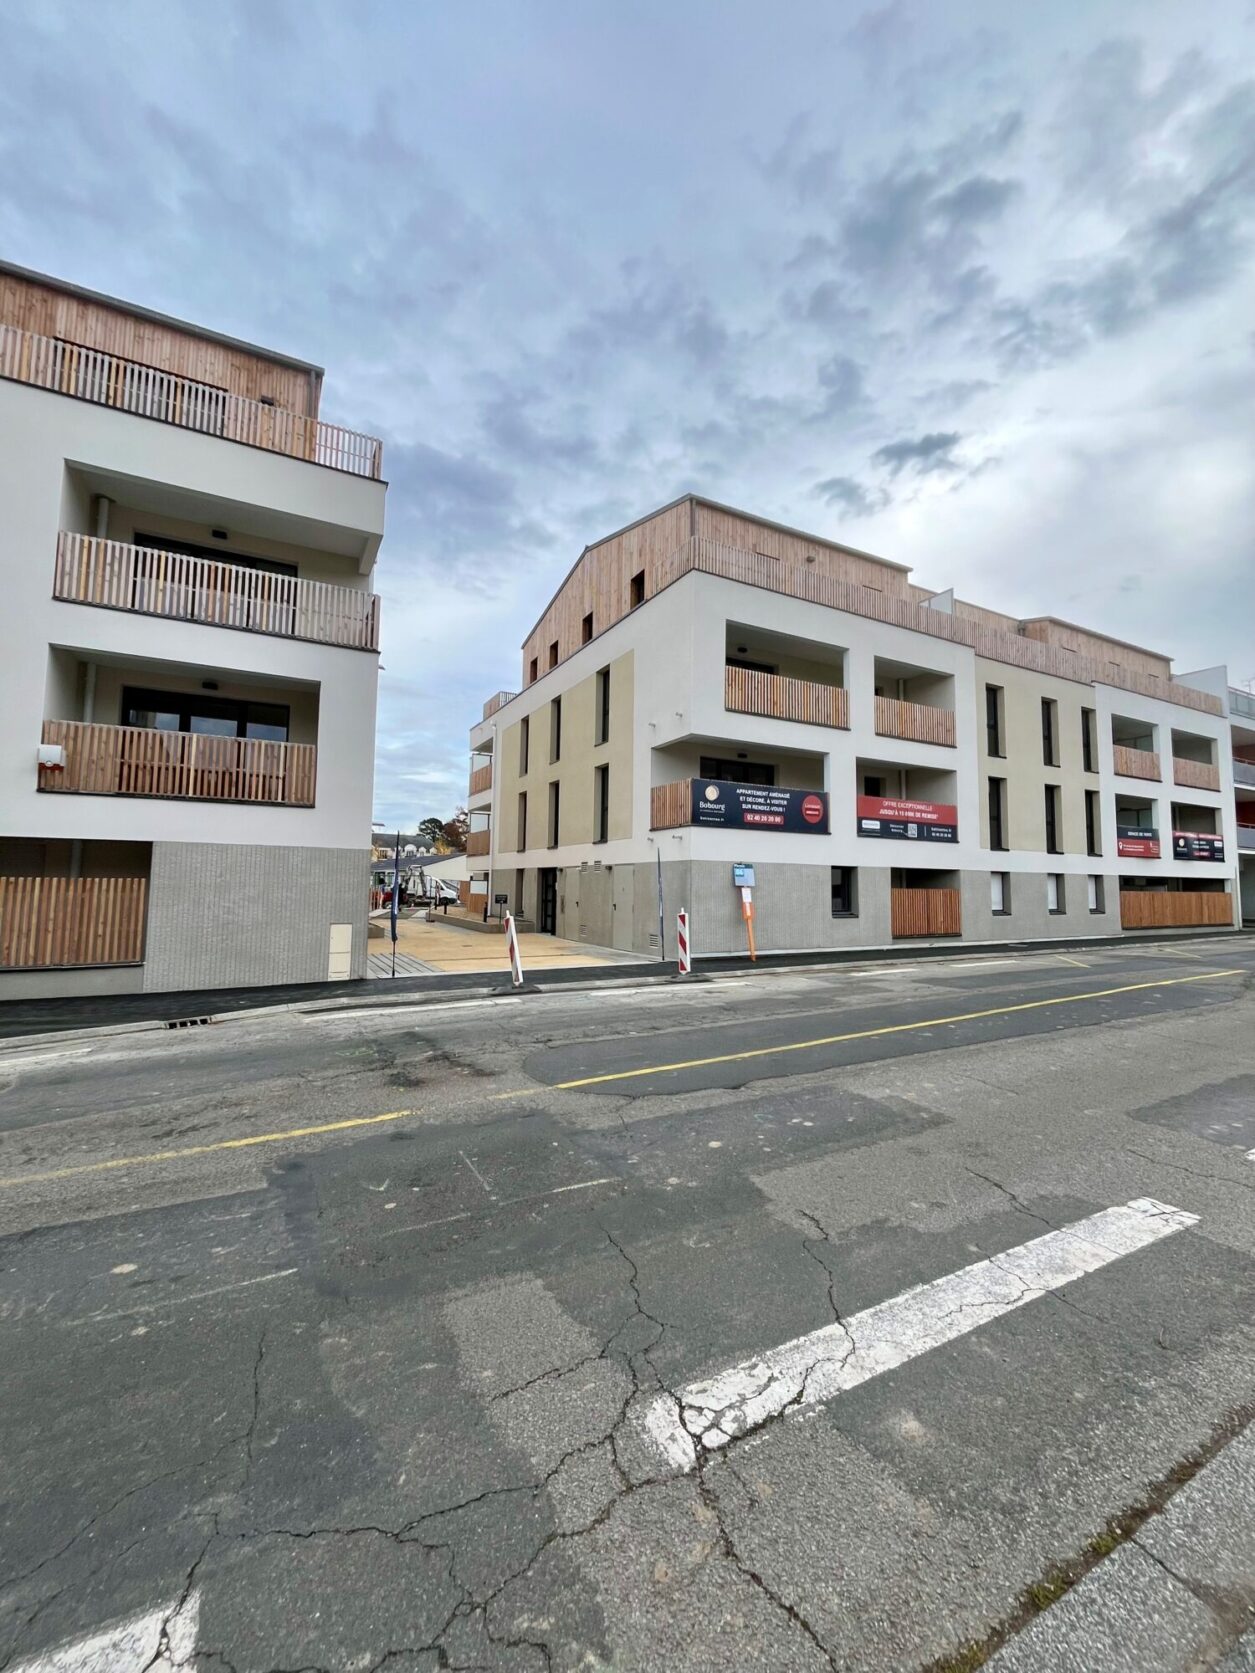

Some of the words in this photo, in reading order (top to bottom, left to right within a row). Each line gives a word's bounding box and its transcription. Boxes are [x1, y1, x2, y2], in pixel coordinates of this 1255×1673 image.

[736, 788, 768, 797] APPARTEMENT
[769, 791, 790, 799] AMÉNAGÉ
[699, 801, 725, 811] Bobourg
[752, 804, 783, 812] RENDEZ-VOUS
[898, 801, 933, 811] EXCEPTIONNELLE
[879, 808, 898, 816] JUSQU'À
